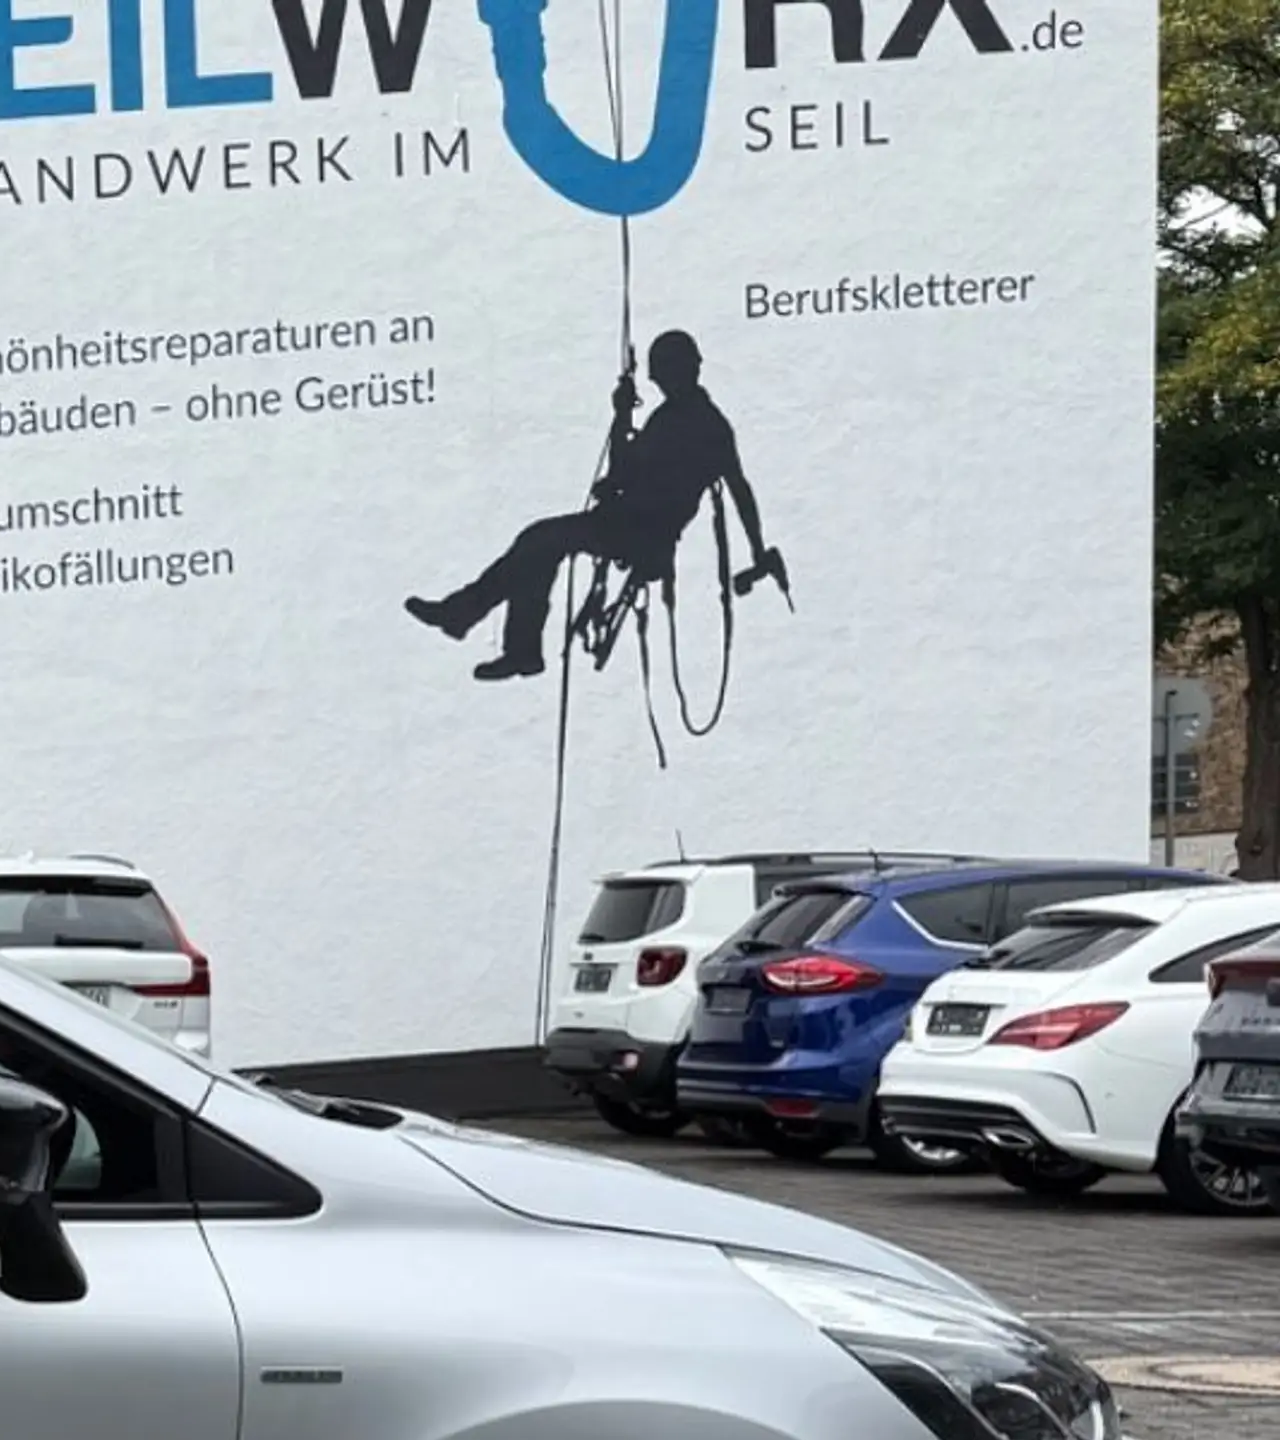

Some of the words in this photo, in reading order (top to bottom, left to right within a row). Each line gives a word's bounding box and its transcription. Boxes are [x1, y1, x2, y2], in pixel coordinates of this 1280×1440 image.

[393, 127, 472, 177] IM
[744, 100, 890, 153] SEIL
[744, 273, 1036, 319] Berufskletterer
[389, 315, 435, 344] an
[185, 383, 282, 422] ohne
[294, 368, 436, 413] Gerüst!
